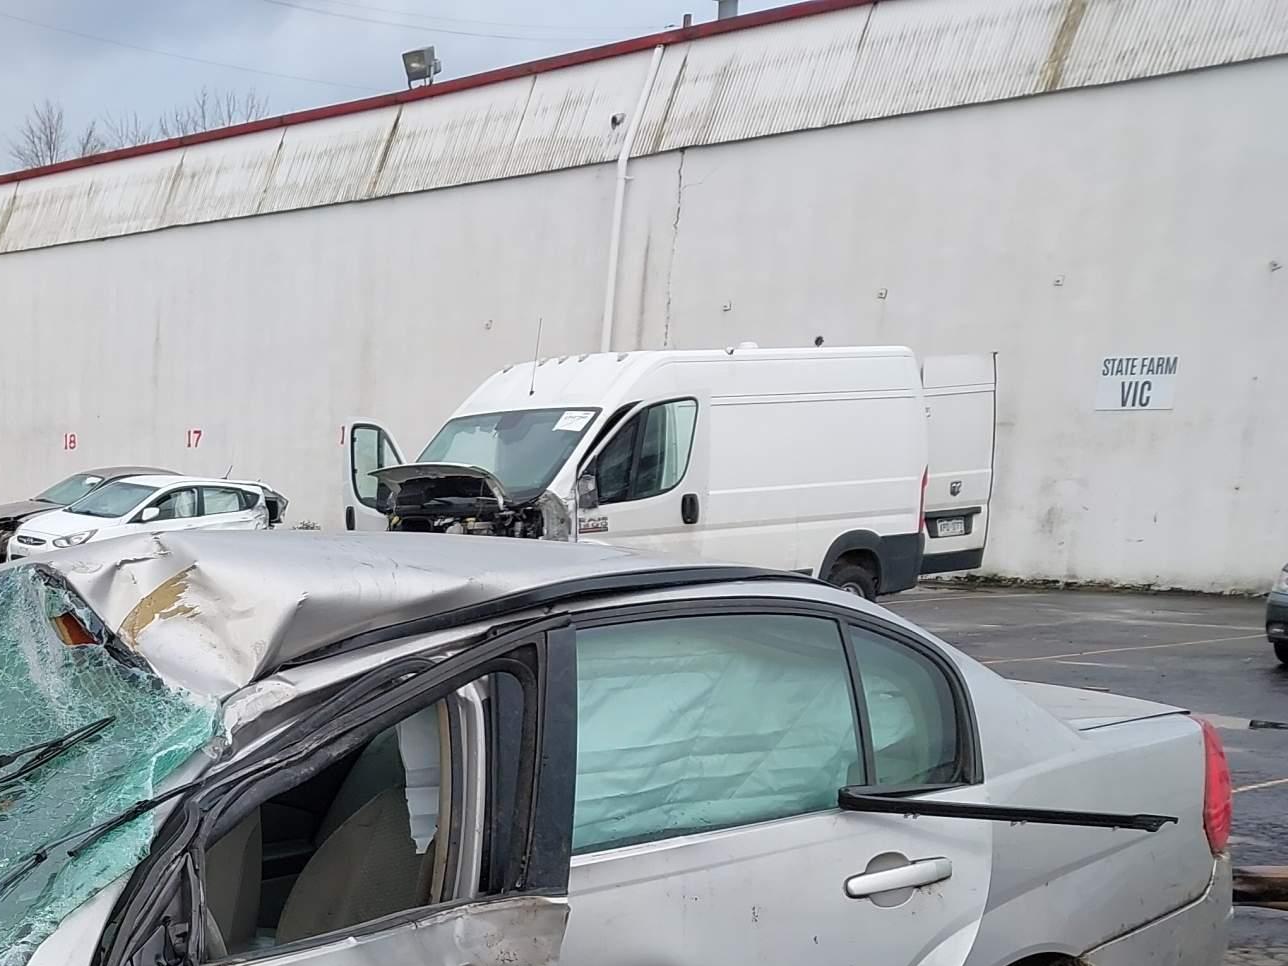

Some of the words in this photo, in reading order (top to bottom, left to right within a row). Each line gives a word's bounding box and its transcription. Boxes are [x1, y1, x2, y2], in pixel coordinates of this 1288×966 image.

[1102, 358, 1138, 376] STATE
[1140, 357, 1178, 375] FARM
[1121, 381, 1151, 407] VIC
[64, 433, 77, 450] 18
[187, 429, 202, 448] 17
